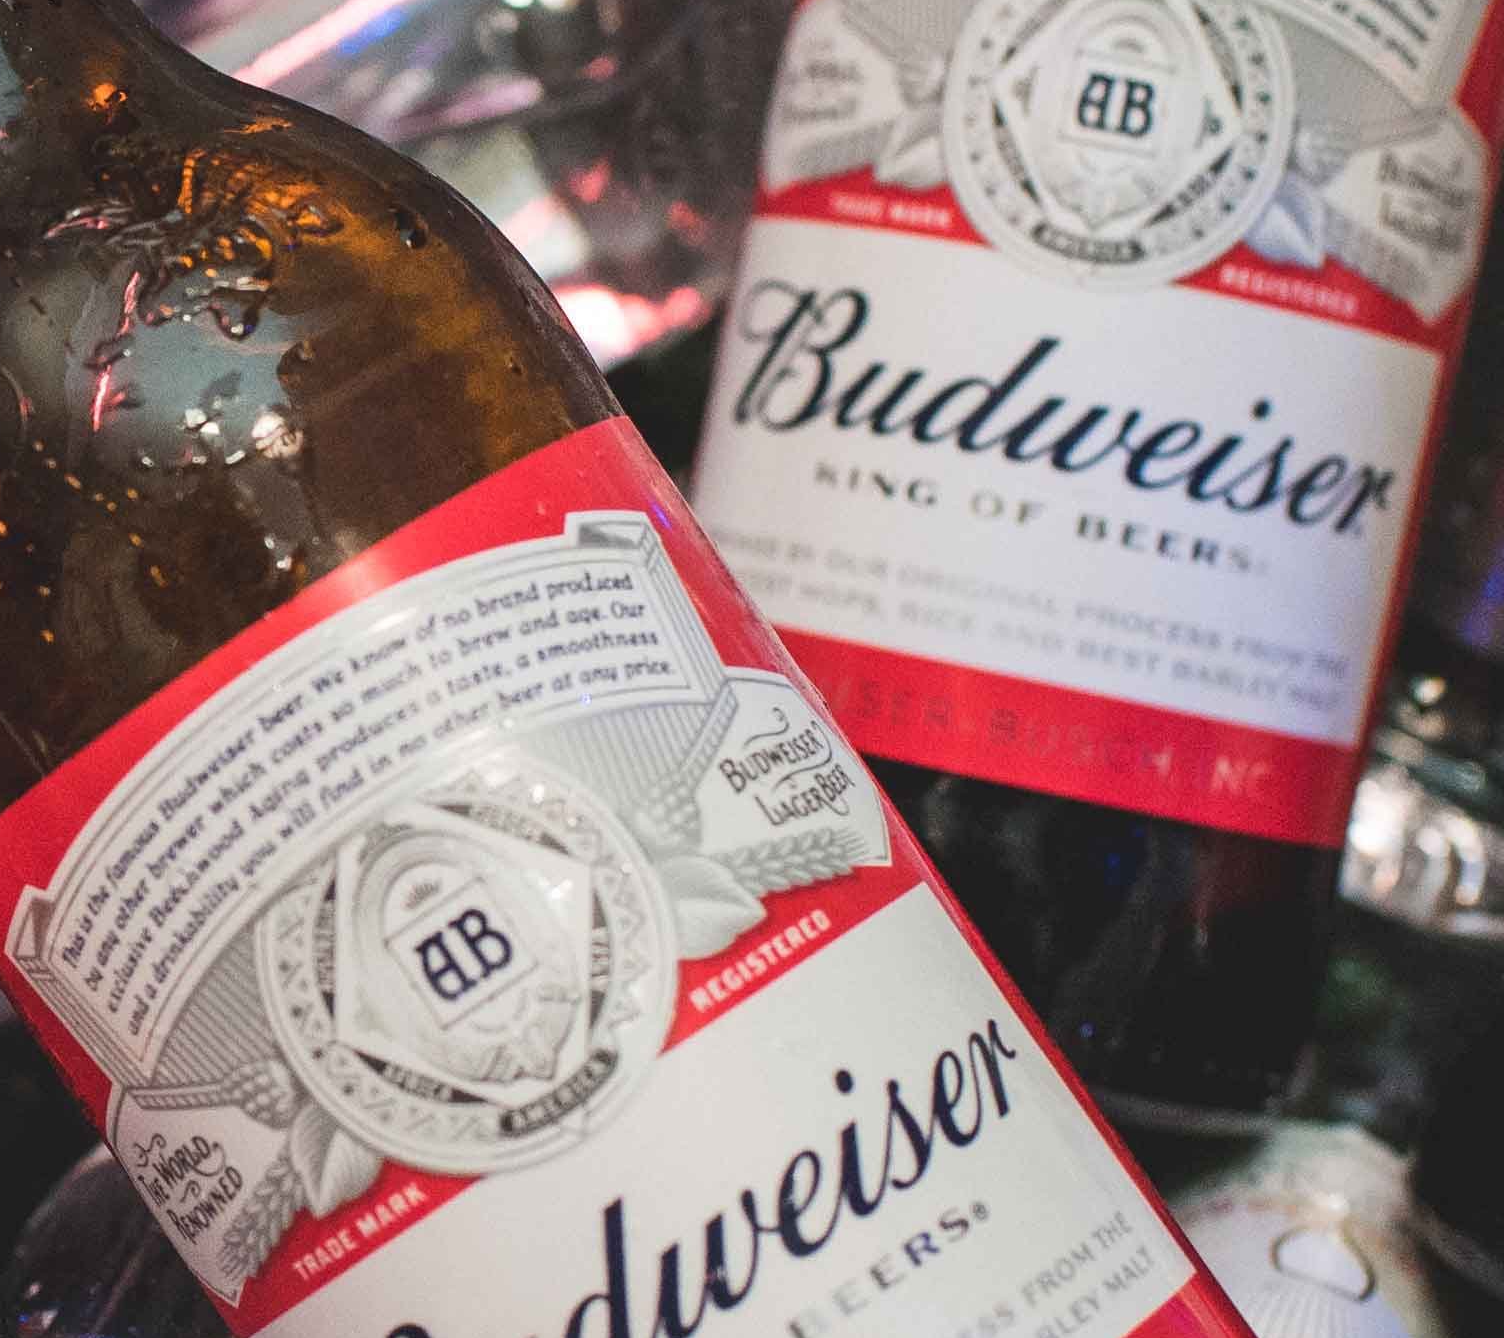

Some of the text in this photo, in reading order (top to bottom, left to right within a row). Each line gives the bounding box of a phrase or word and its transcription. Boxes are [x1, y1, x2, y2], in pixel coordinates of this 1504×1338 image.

[1074, 71, 1156, 138] AB
[1219, 265, 1359, 316] REGISTERED
[733, 278, 1390, 536] Budweiser
[814, 461, 1044, 527] KING OF
[718, 723, 826, 795] BUDWEISER
[415, 907, 512, 1002] AB
[689, 909, 835, 1014] REGISTERED
[292, 1181, 431, 1282] TRADE MARK
[1018, 1242, 1096, 1309] FROM
[1090, 1210, 1135, 1254] THE
[1101, 1244, 1158, 1297] MALT
